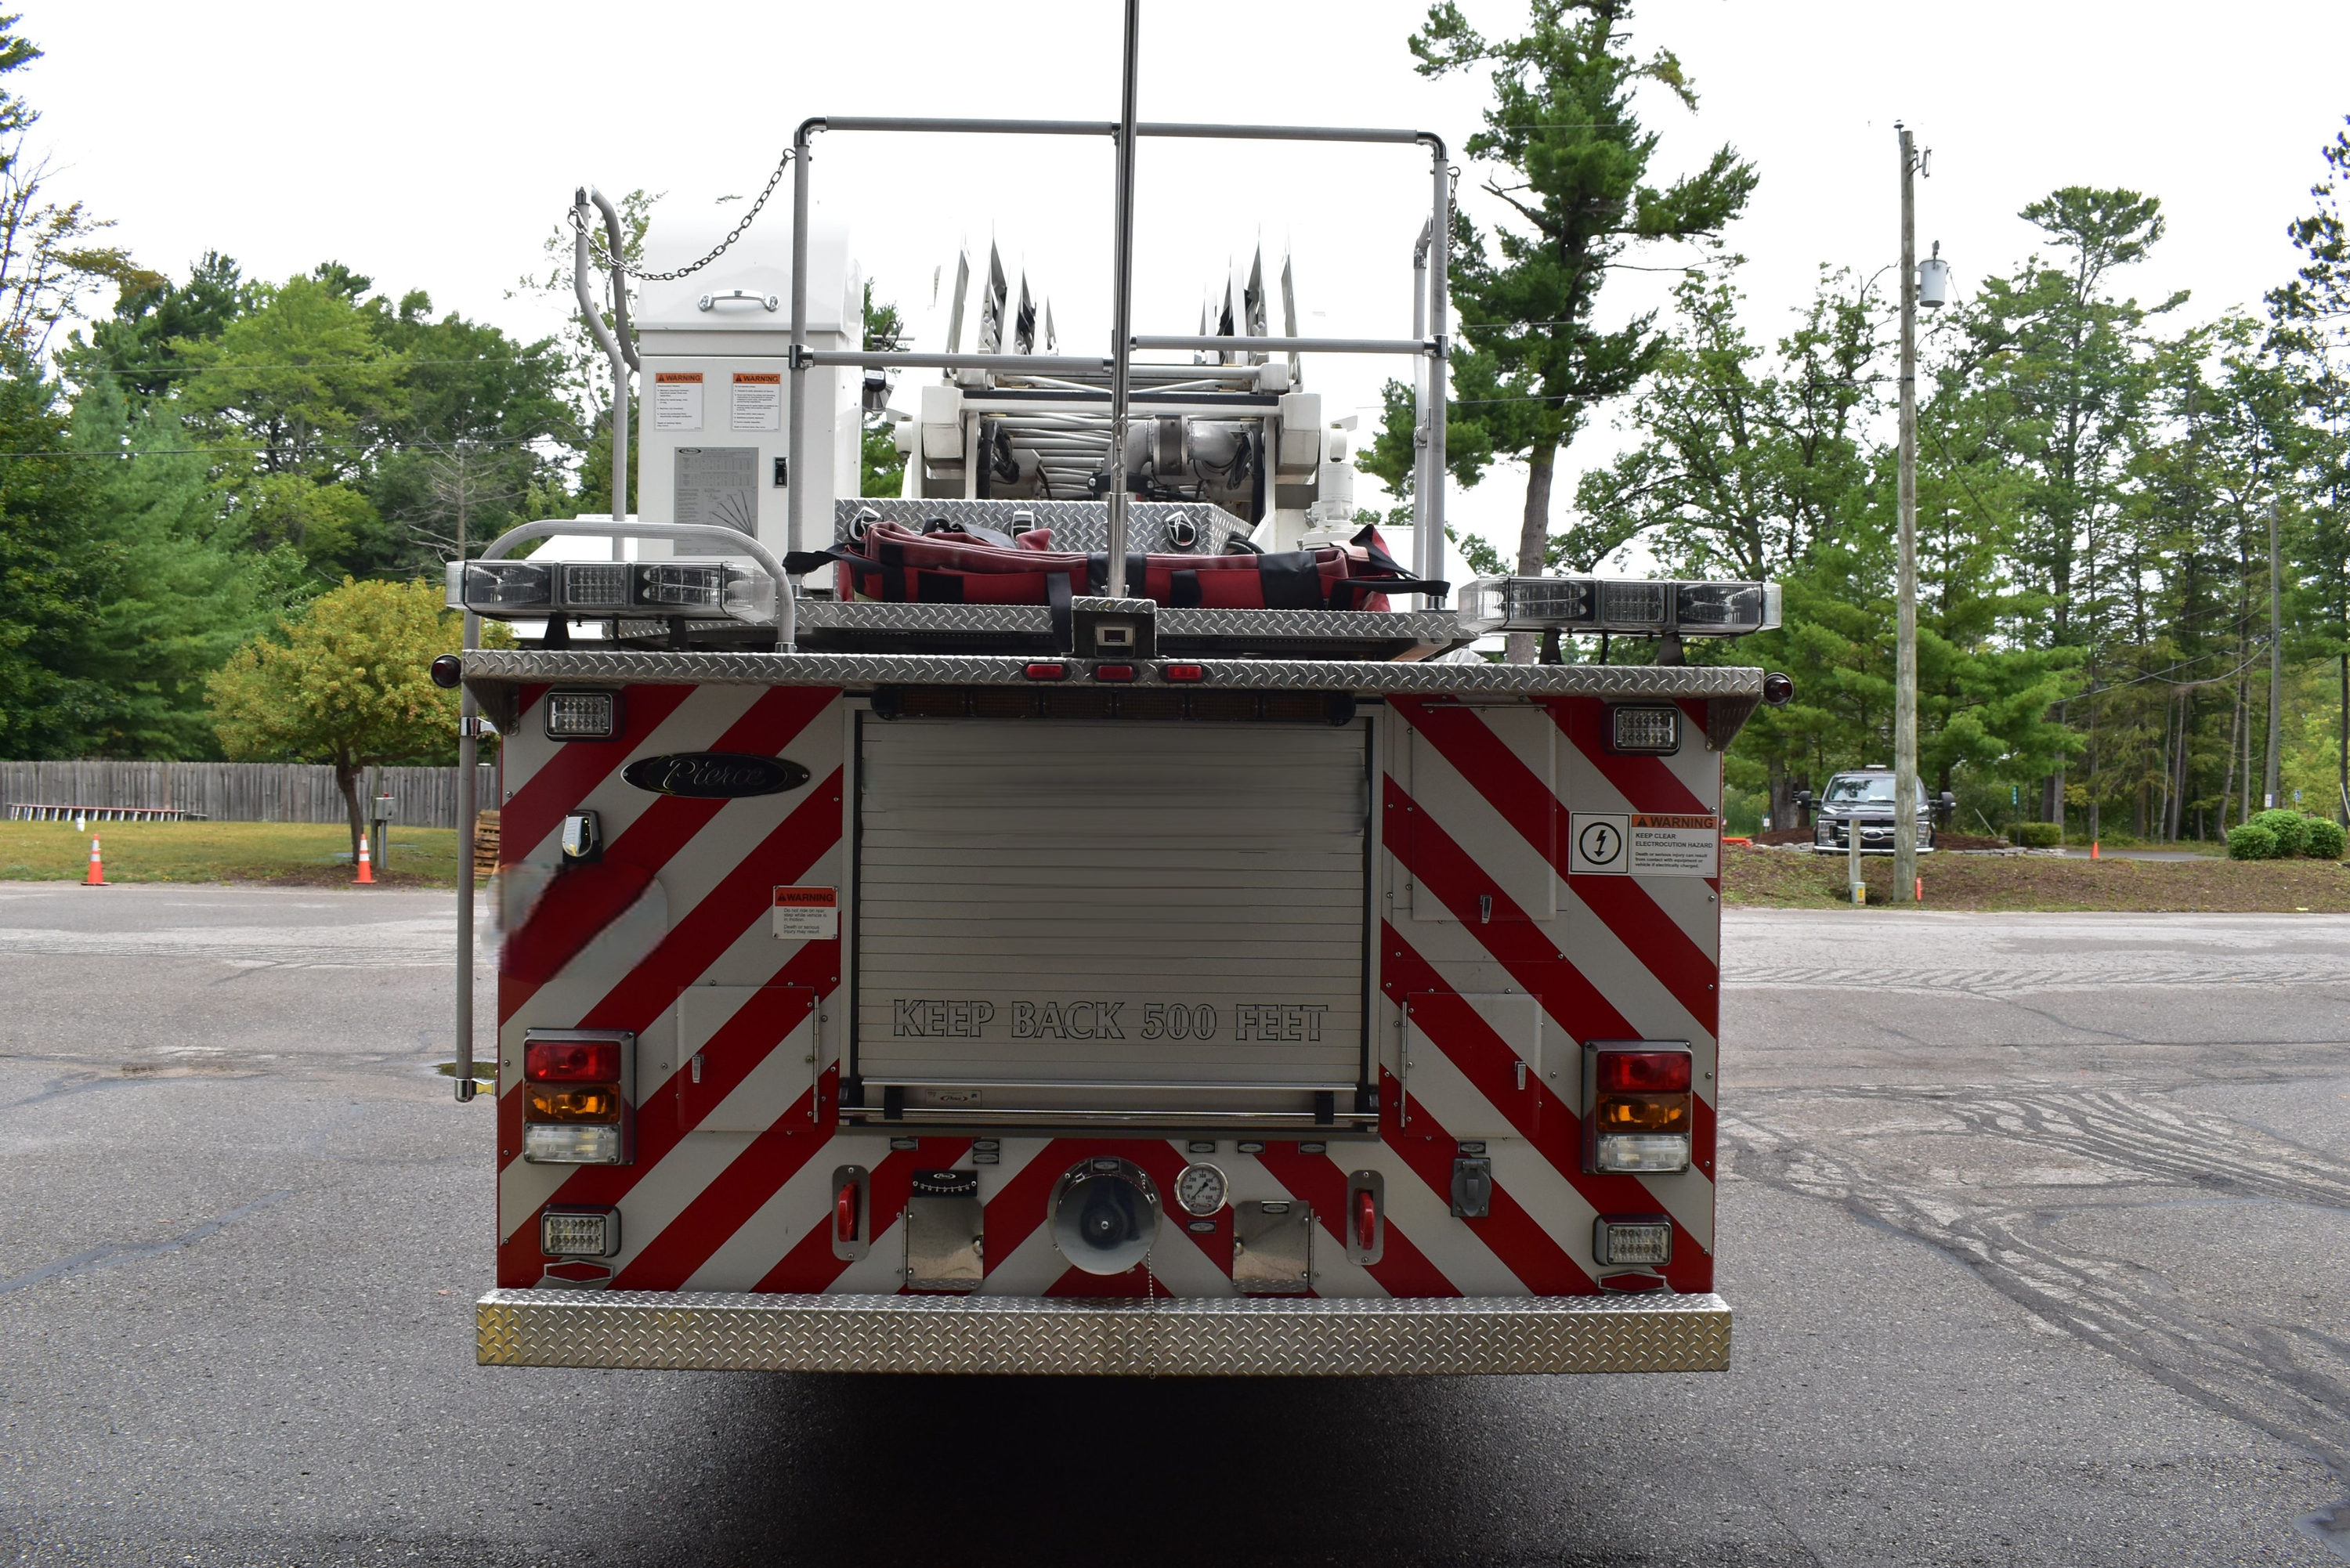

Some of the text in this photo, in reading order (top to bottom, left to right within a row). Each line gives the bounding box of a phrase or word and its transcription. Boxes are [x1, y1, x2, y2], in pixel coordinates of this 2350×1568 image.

[662, 757, 766, 789] Pierce
[1650, 816, 1713, 828] WARNING
[786, 893, 833, 902] WARNING
[894, 999, 1329, 1042] KEEP BACK 500 FEET
